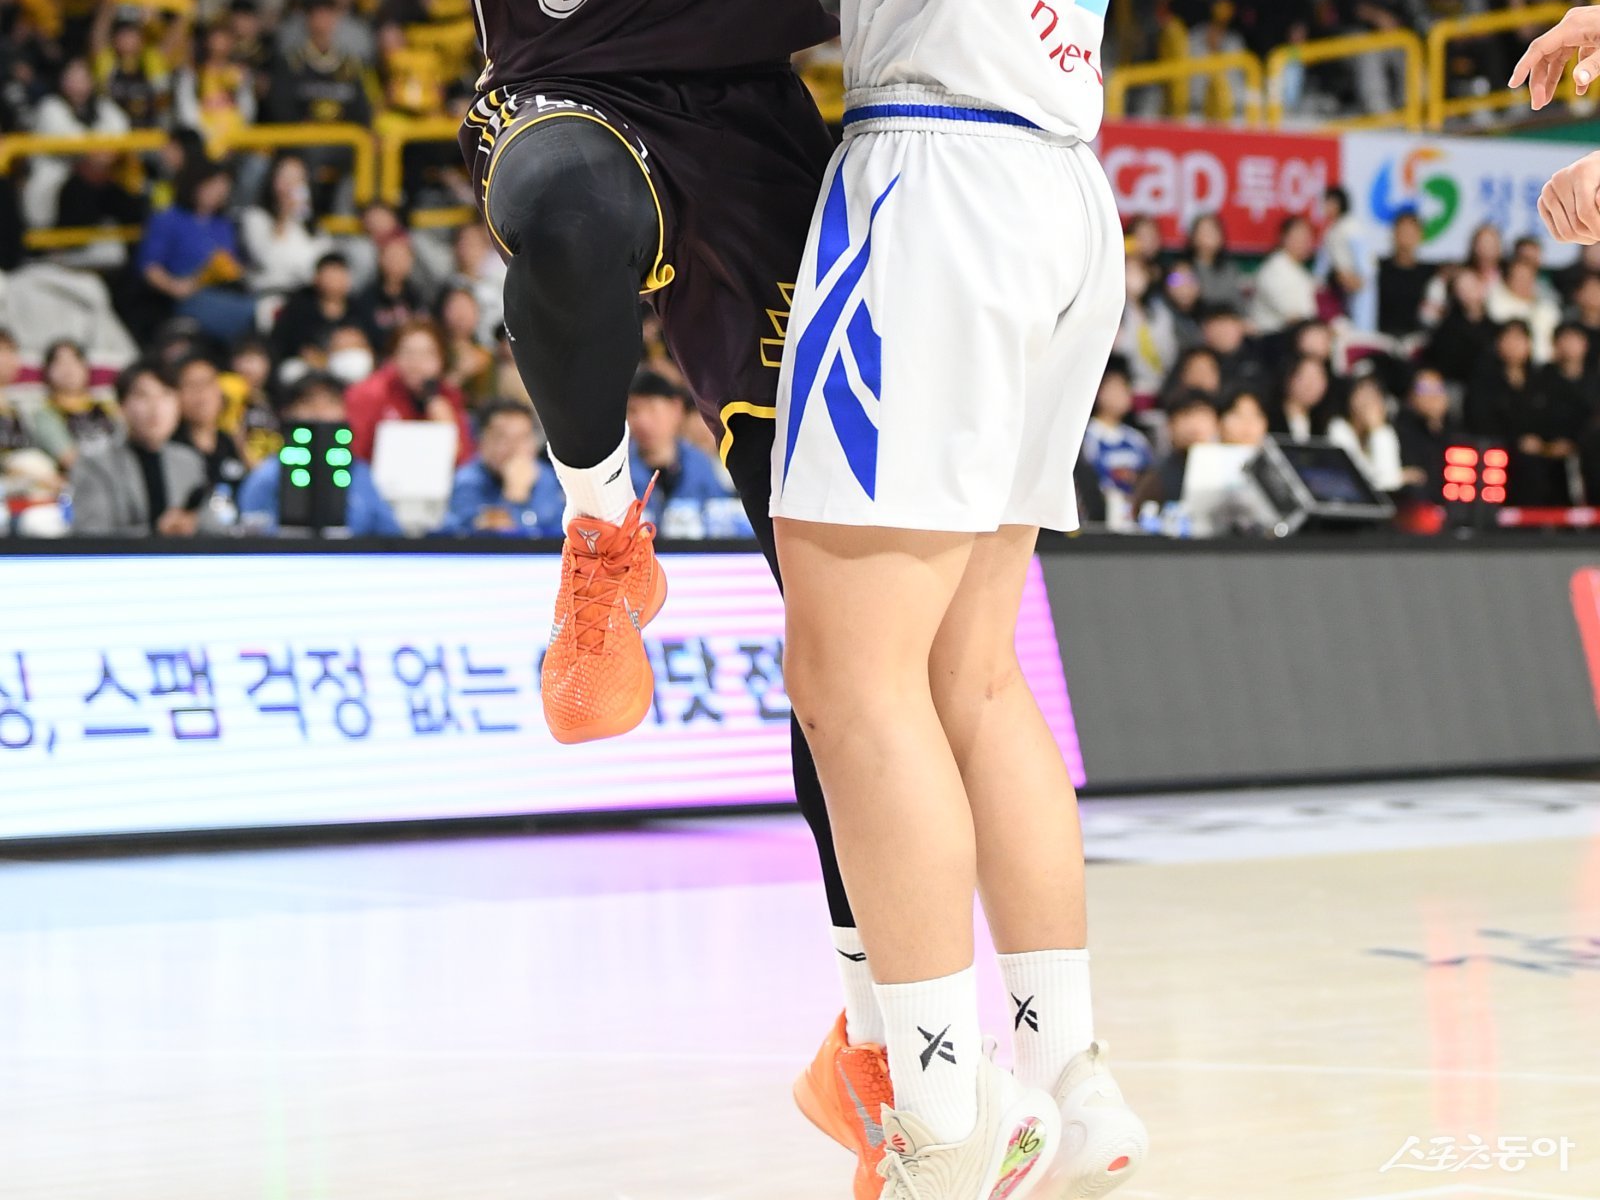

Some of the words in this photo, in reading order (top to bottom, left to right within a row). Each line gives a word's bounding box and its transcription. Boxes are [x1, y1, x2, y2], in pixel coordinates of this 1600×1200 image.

[84, 647, 220, 740] 스팸
[240, 643, 373, 739] 걱정
[394, 644, 519, 732] 없는
